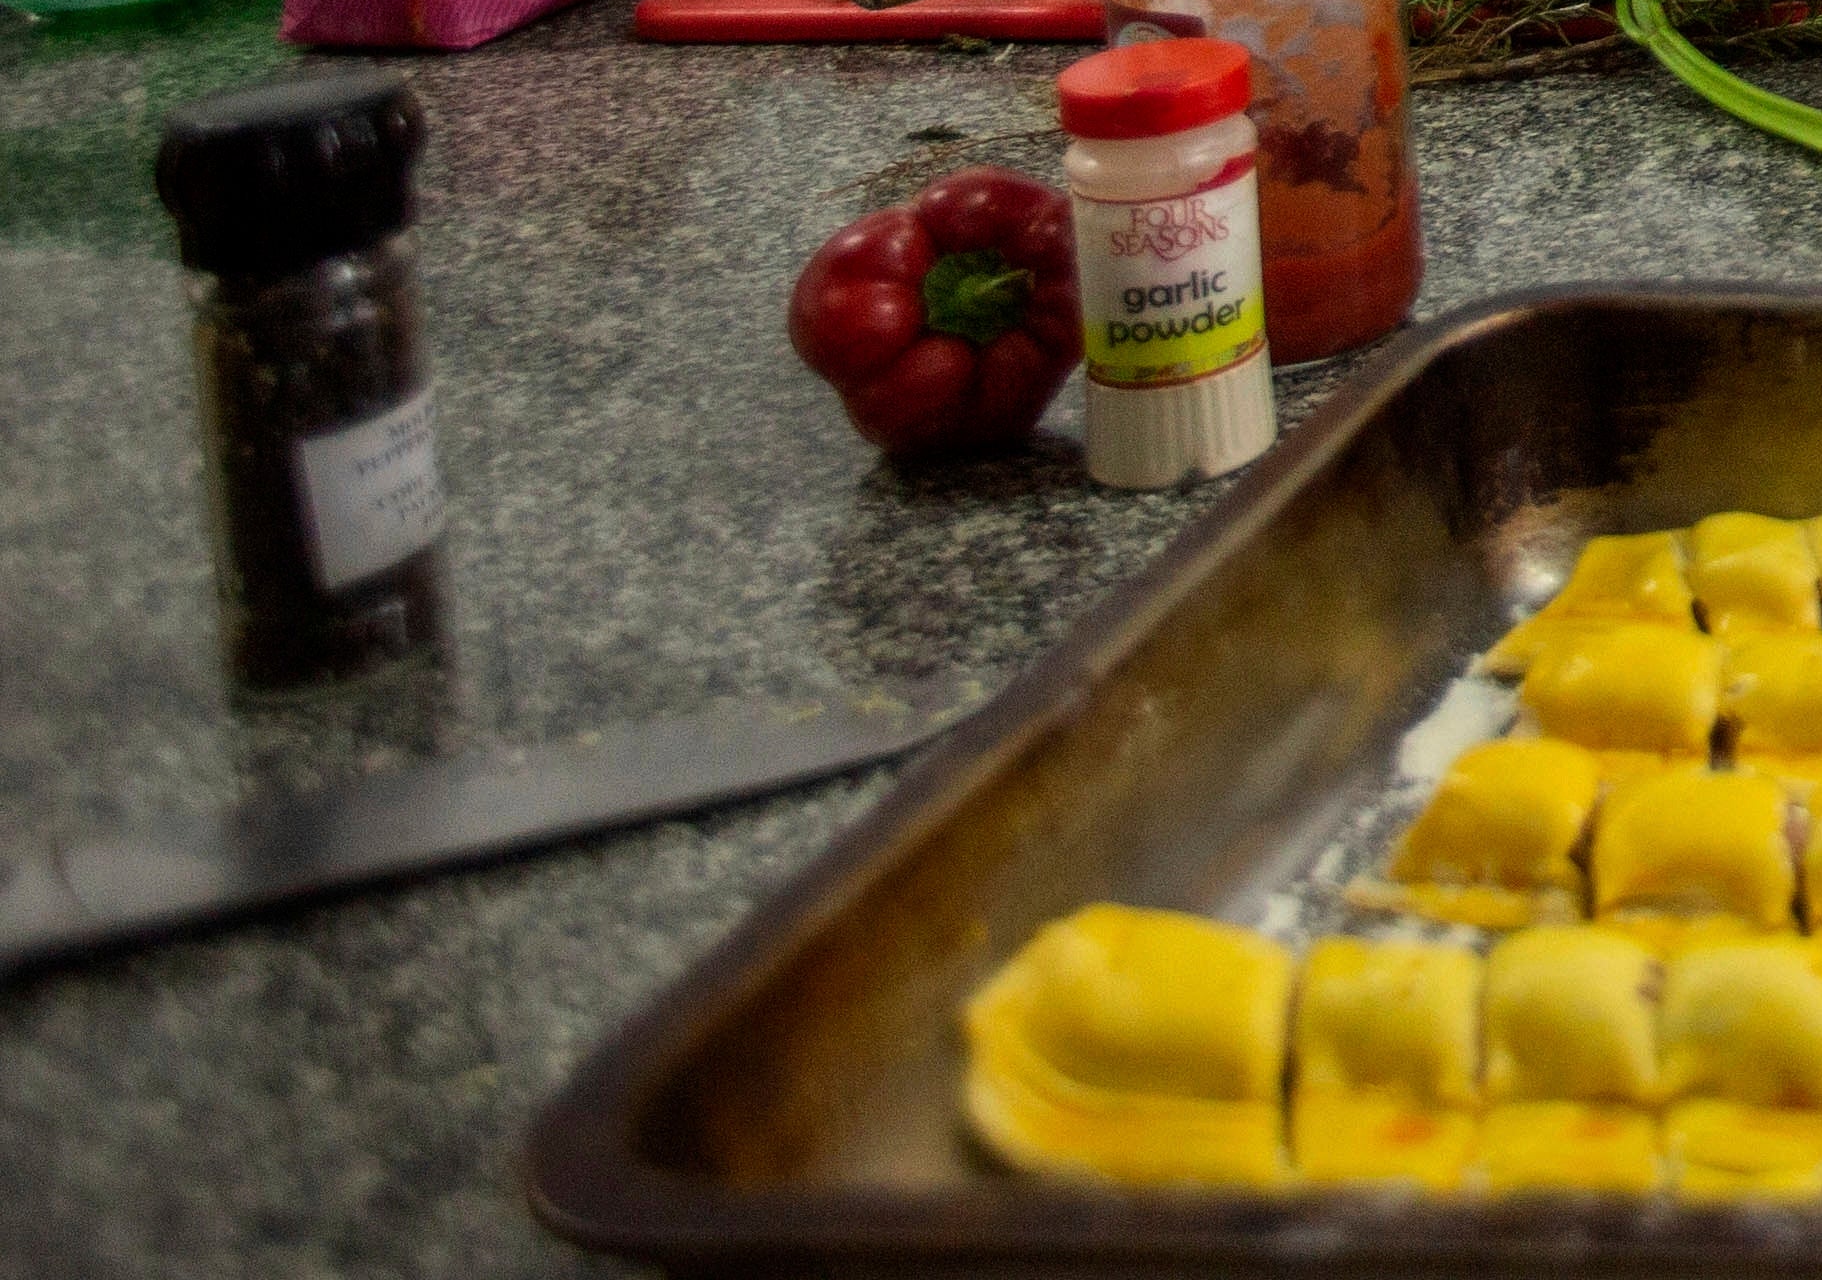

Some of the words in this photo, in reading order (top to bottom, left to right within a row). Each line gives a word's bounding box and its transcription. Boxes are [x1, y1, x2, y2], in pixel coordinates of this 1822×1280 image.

[1110, 216, 1230, 258] SEASONS
[1131, 197, 1214, 233] FOUR
[1123, 268, 1228, 314] garlic
[1107, 296, 1246, 348] powder
